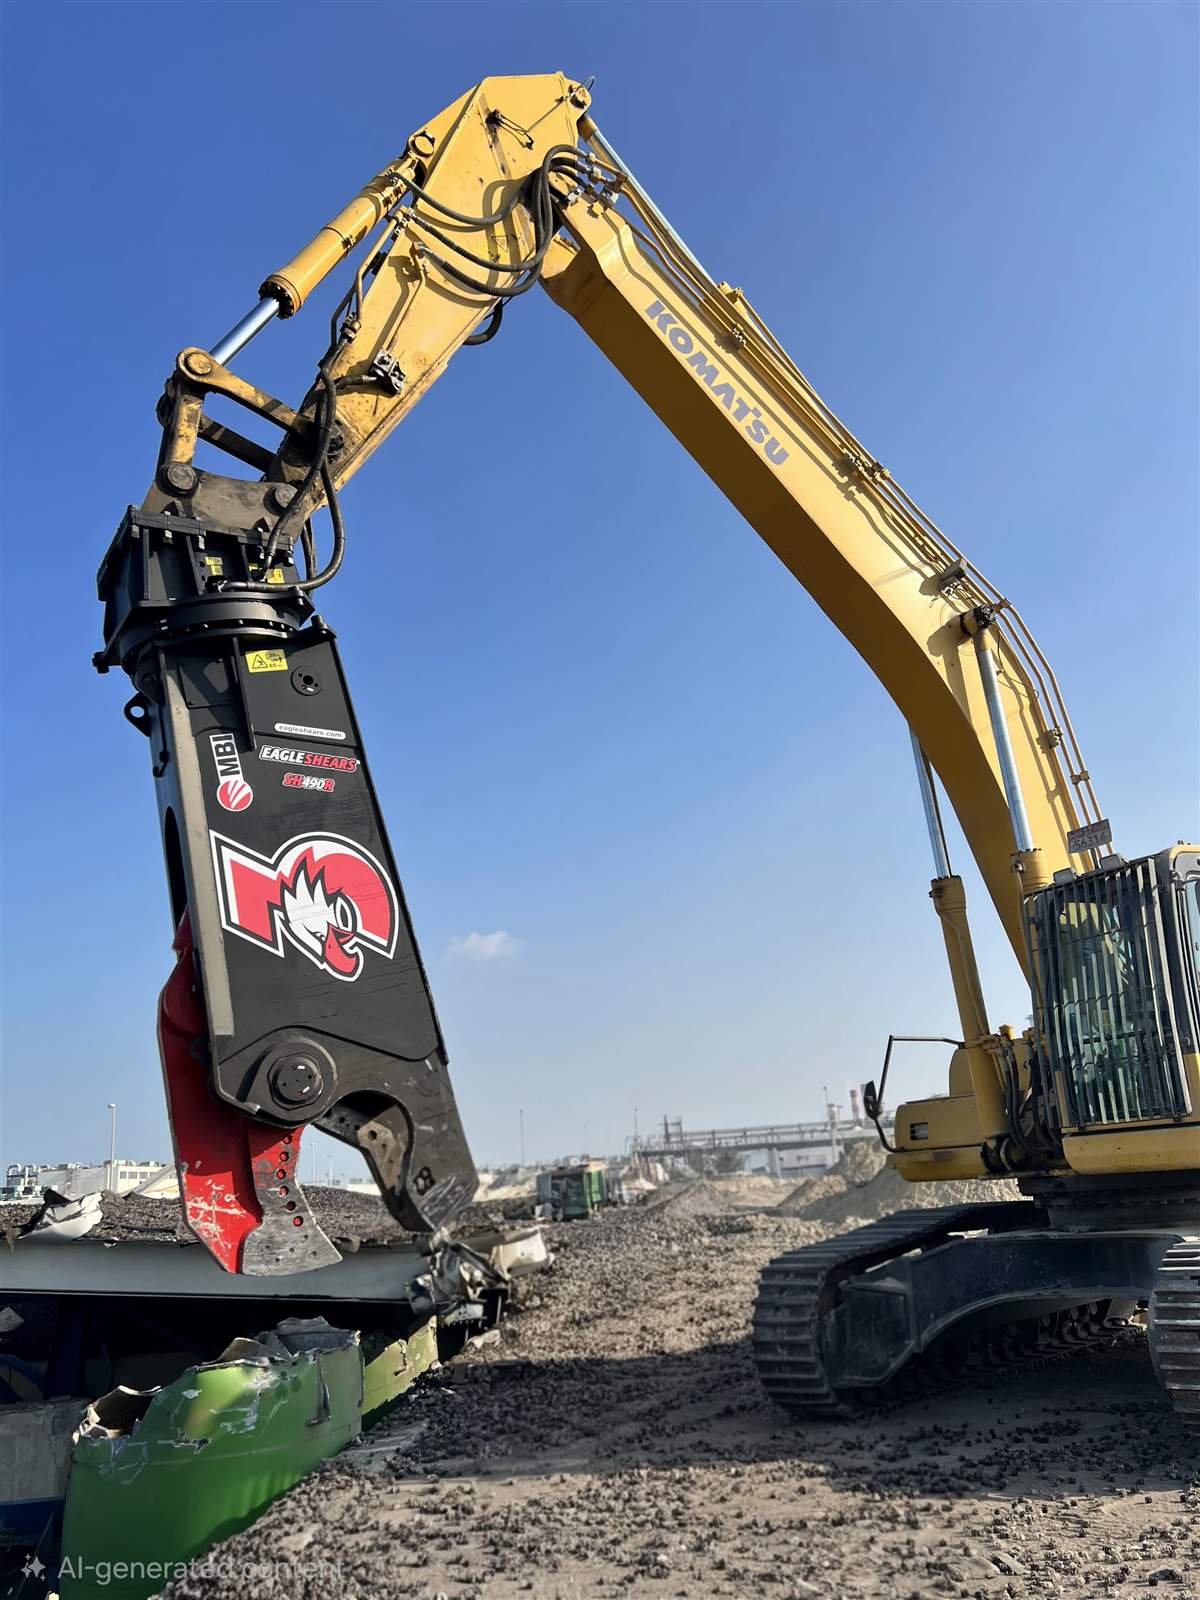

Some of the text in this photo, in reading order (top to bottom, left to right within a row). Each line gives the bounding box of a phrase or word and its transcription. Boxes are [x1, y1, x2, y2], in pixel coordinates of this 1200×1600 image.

[645, 299, 789, 466] KOMATSU
[279, 724, 342, 738] eagleshears.com
[212, 734, 240, 777] MBI
[284, 774, 333, 791] SH490R
